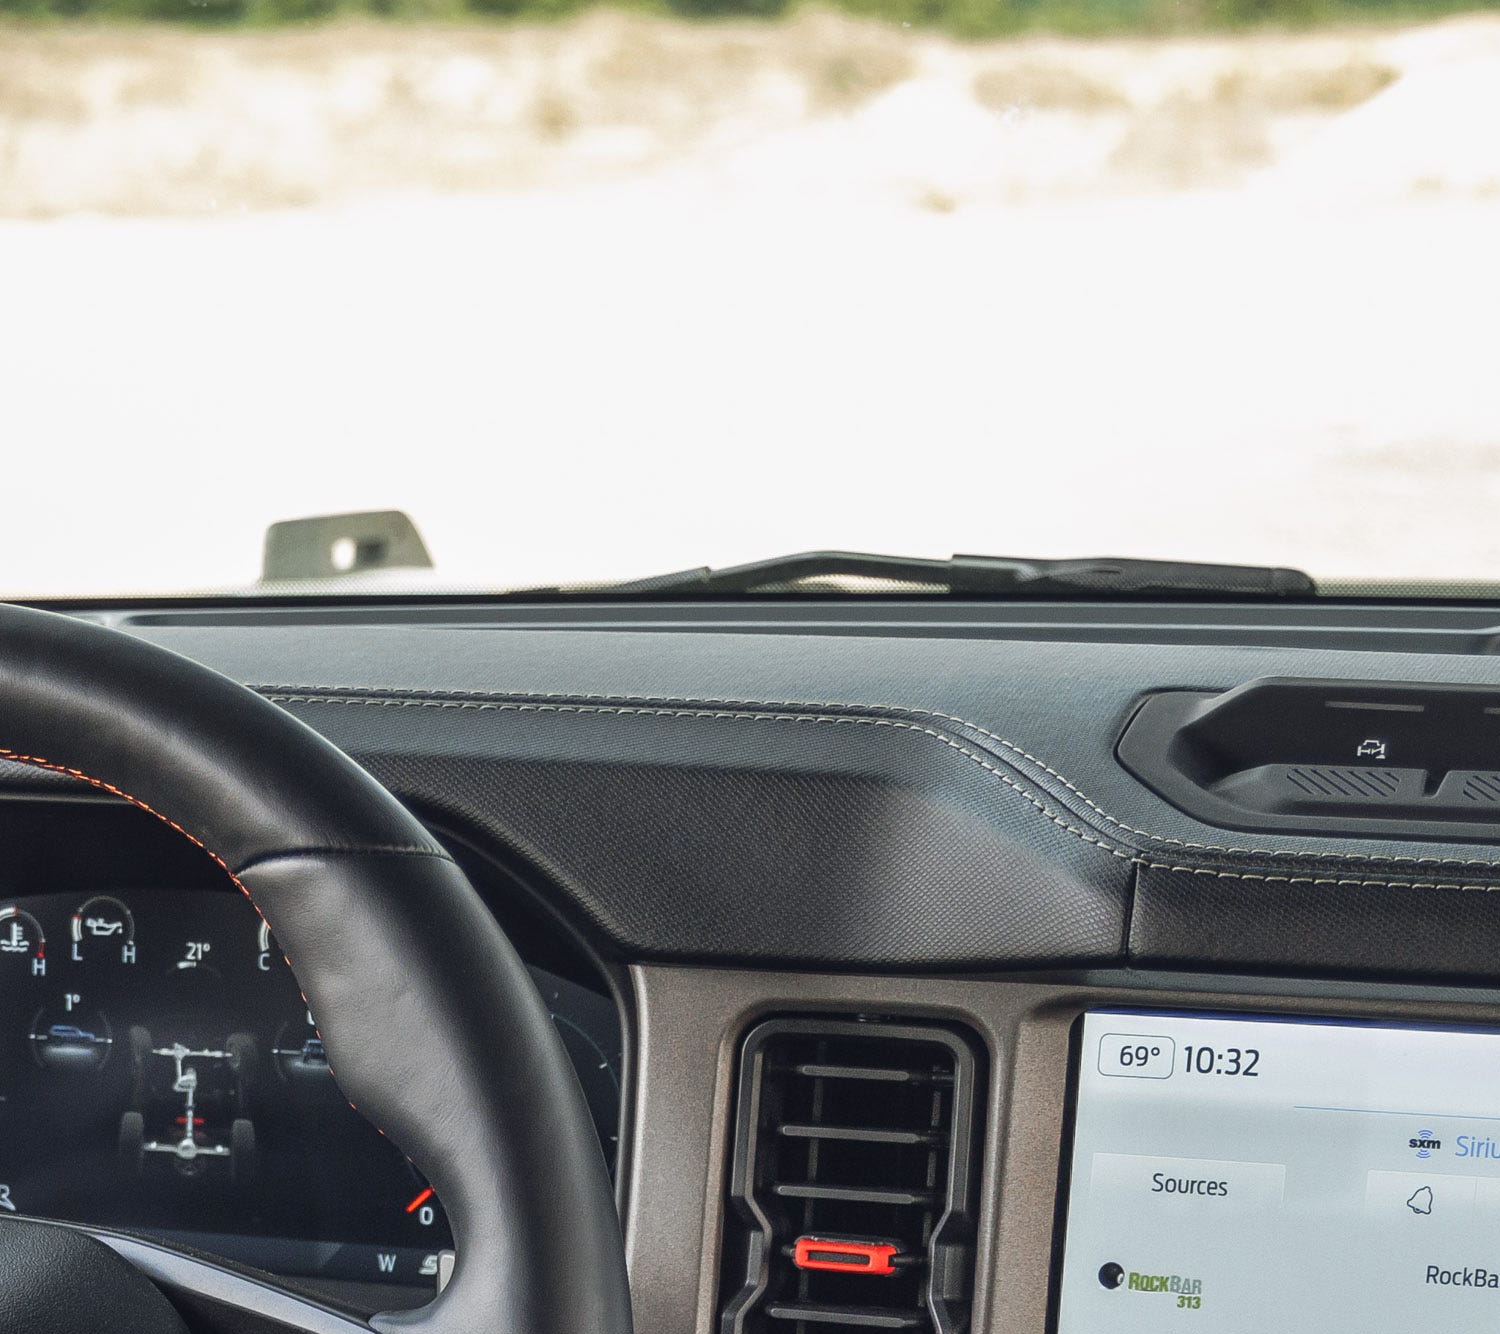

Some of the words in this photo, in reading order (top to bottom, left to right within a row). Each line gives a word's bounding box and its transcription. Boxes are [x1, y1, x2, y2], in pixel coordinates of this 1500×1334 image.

[71, 943, 83, 961] L
[122, 945, 136, 963] H
[32, 958, 46, 976] H
[258, 953, 270, 971] C
[1119, 1045, 1161, 1067] 69°
[1183, 1045, 1260, 1077] 10:32
[1408, 1138, 1442, 1150] sxm
[1151, 1172, 1228, 1198] Sources
[419, 1206, 434, 1226] 0
[1177, 1295, 1201, 1310] 313
